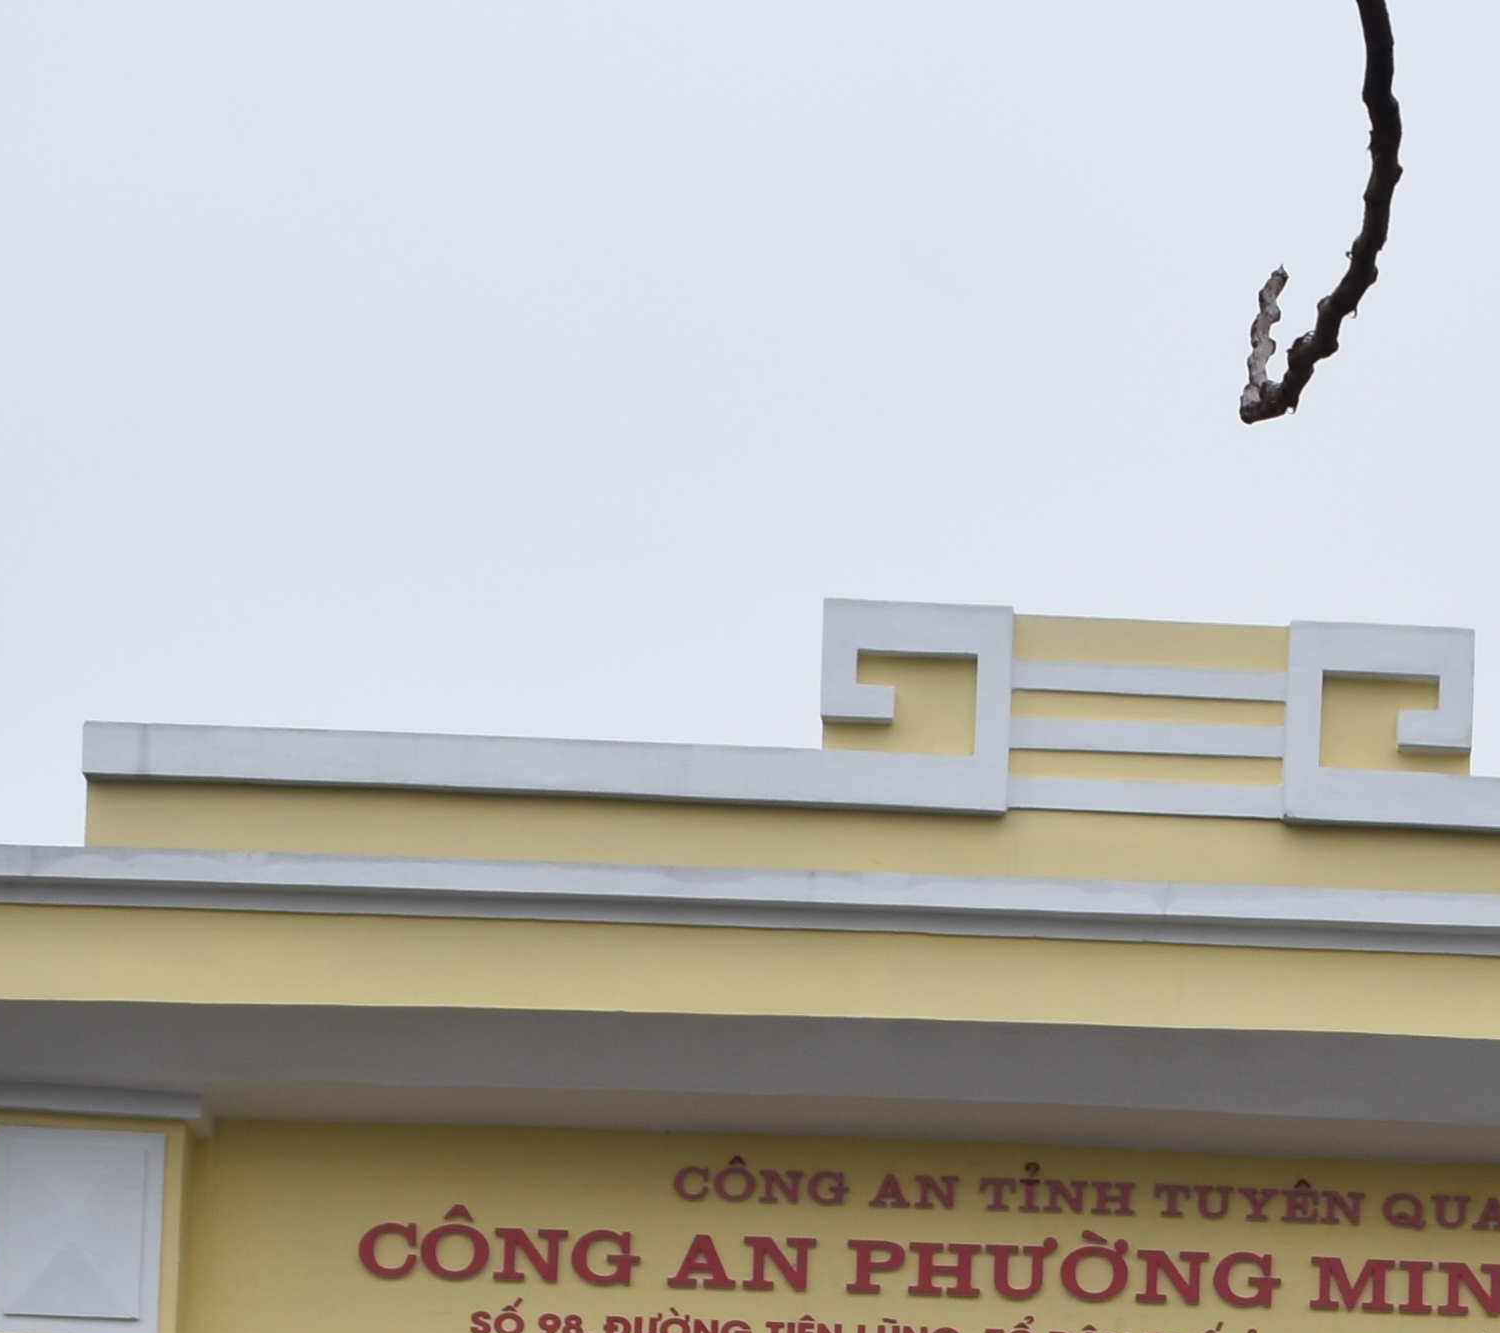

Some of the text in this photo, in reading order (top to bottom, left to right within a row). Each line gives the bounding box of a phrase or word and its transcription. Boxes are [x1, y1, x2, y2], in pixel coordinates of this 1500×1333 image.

[673, 1155, 850, 1204] CÔNG
[870, 1173, 959, 1209] AN
[979, 1162, 1136, 1216] TỈNH
[1154, 1178, 1366, 1226] TUYÊN
[358, 1203, 642, 1287] CÔNG
[667, 1233, 818, 1292] AN
[846, 1230, 1281, 1309] PHƯỜNG
